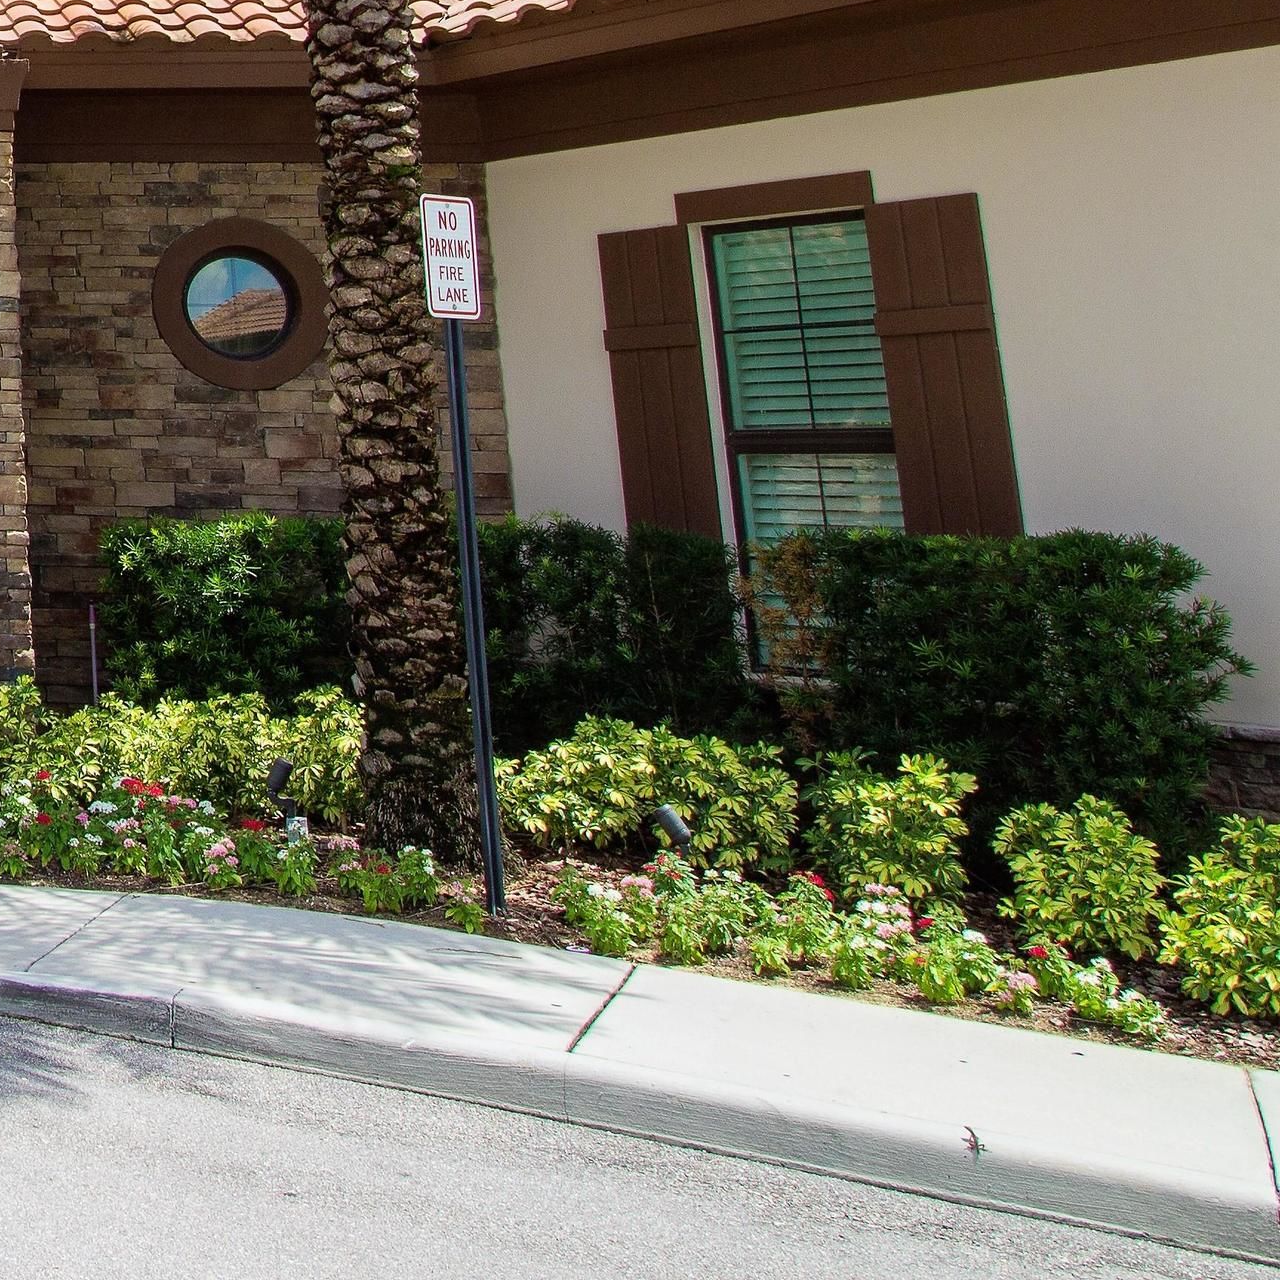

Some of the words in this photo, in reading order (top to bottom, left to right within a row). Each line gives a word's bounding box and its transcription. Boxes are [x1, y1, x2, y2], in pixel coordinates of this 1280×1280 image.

[438, 210, 457, 231] NO
[429, 237, 471, 260] PARKING
[439, 265, 465, 282] FIRE
[438, 287, 469, 303] LANE
